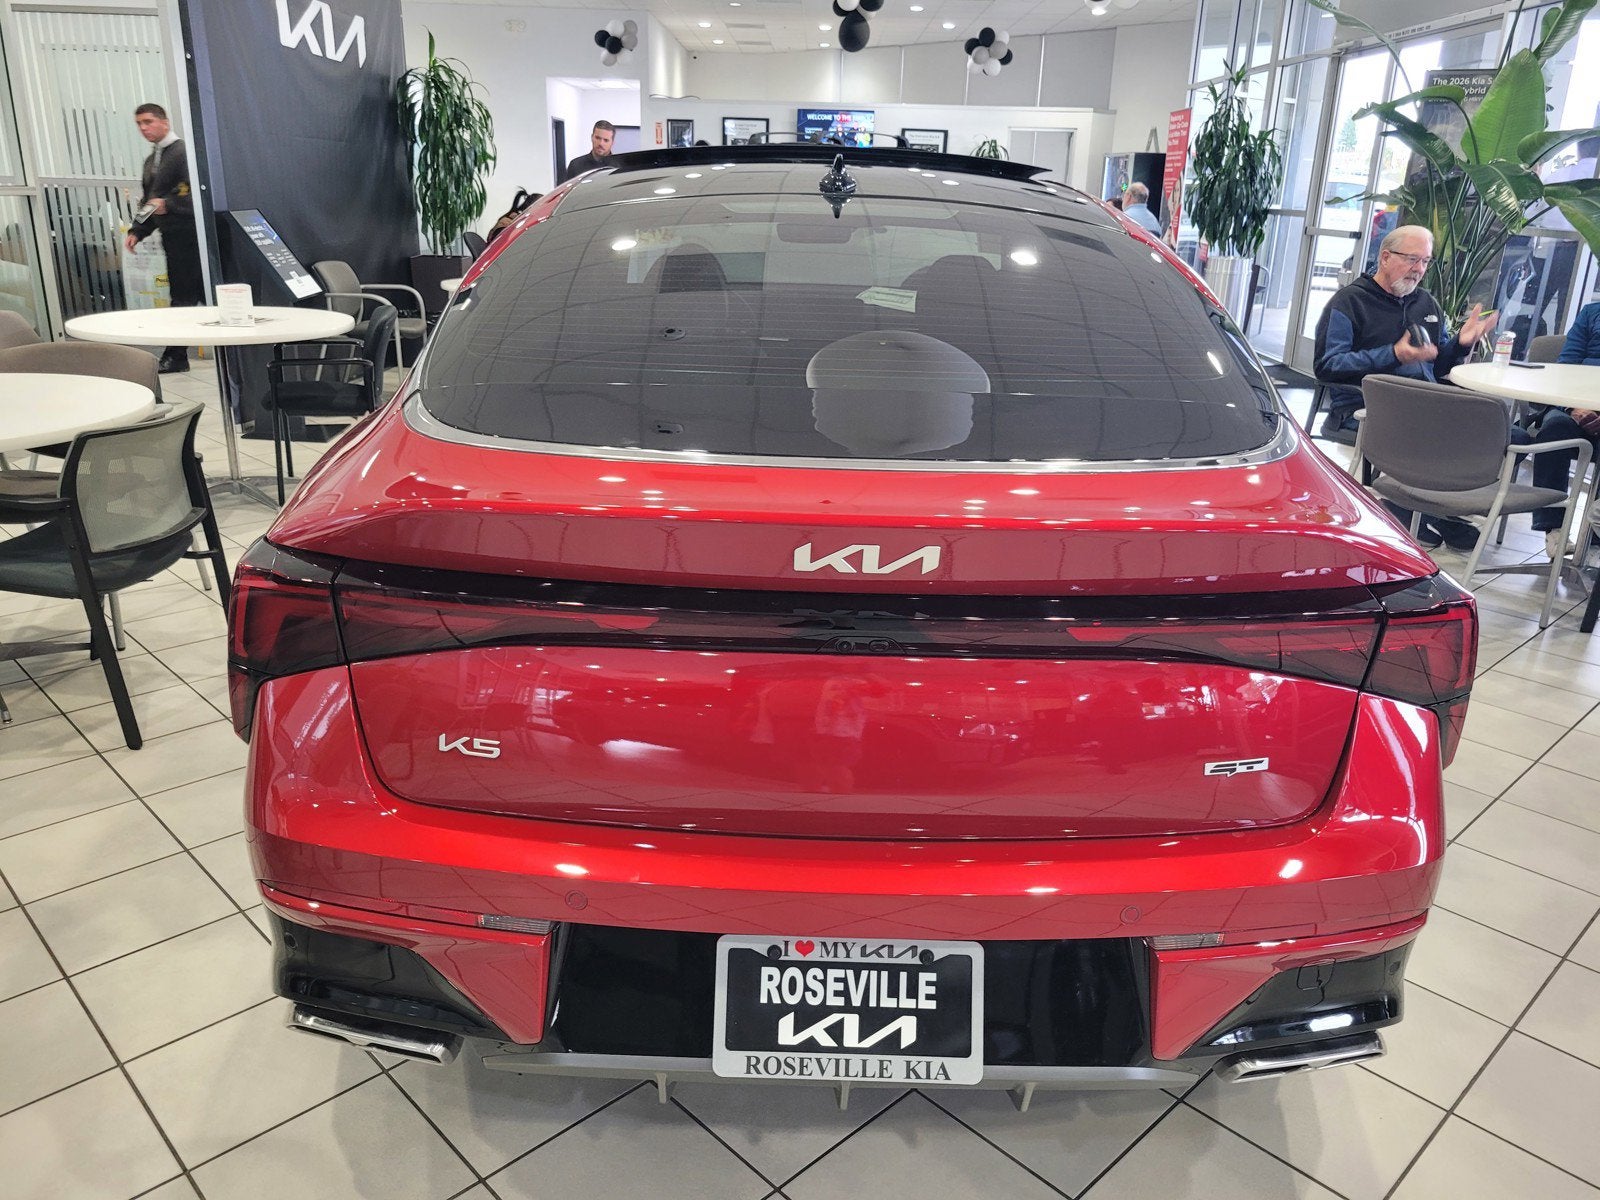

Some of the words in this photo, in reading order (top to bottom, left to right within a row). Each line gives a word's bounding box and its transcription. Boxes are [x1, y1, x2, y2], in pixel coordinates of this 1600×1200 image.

[275, 0, 367, 69] KIA
[1433, 77, 1448, 85] The
[1449, 77, 1470, 85] 2026
[1471, 77, 1485, 85] Kia
[1463, 86, 1486, 95] ybrid
[807, 113, 833, 121] WELCOME
[833, 113, 841, 121] TO
[793, 542, 942, 575] KIA
[438, 733, 501, 759] K5
[1205, 757, 1268, 777] GT
[782, 940, 791, 957] I
[820, 941, 856, 959] MY
[860, 943, 918, 959] KIA
[759, 966, 937, 1010] ROSEVILLE
[777, 1011, 917, 1050] KIA
[744, 1055, 893, 1079] ROSEVILLE
[903, 1060, 952, 1081] KIA
